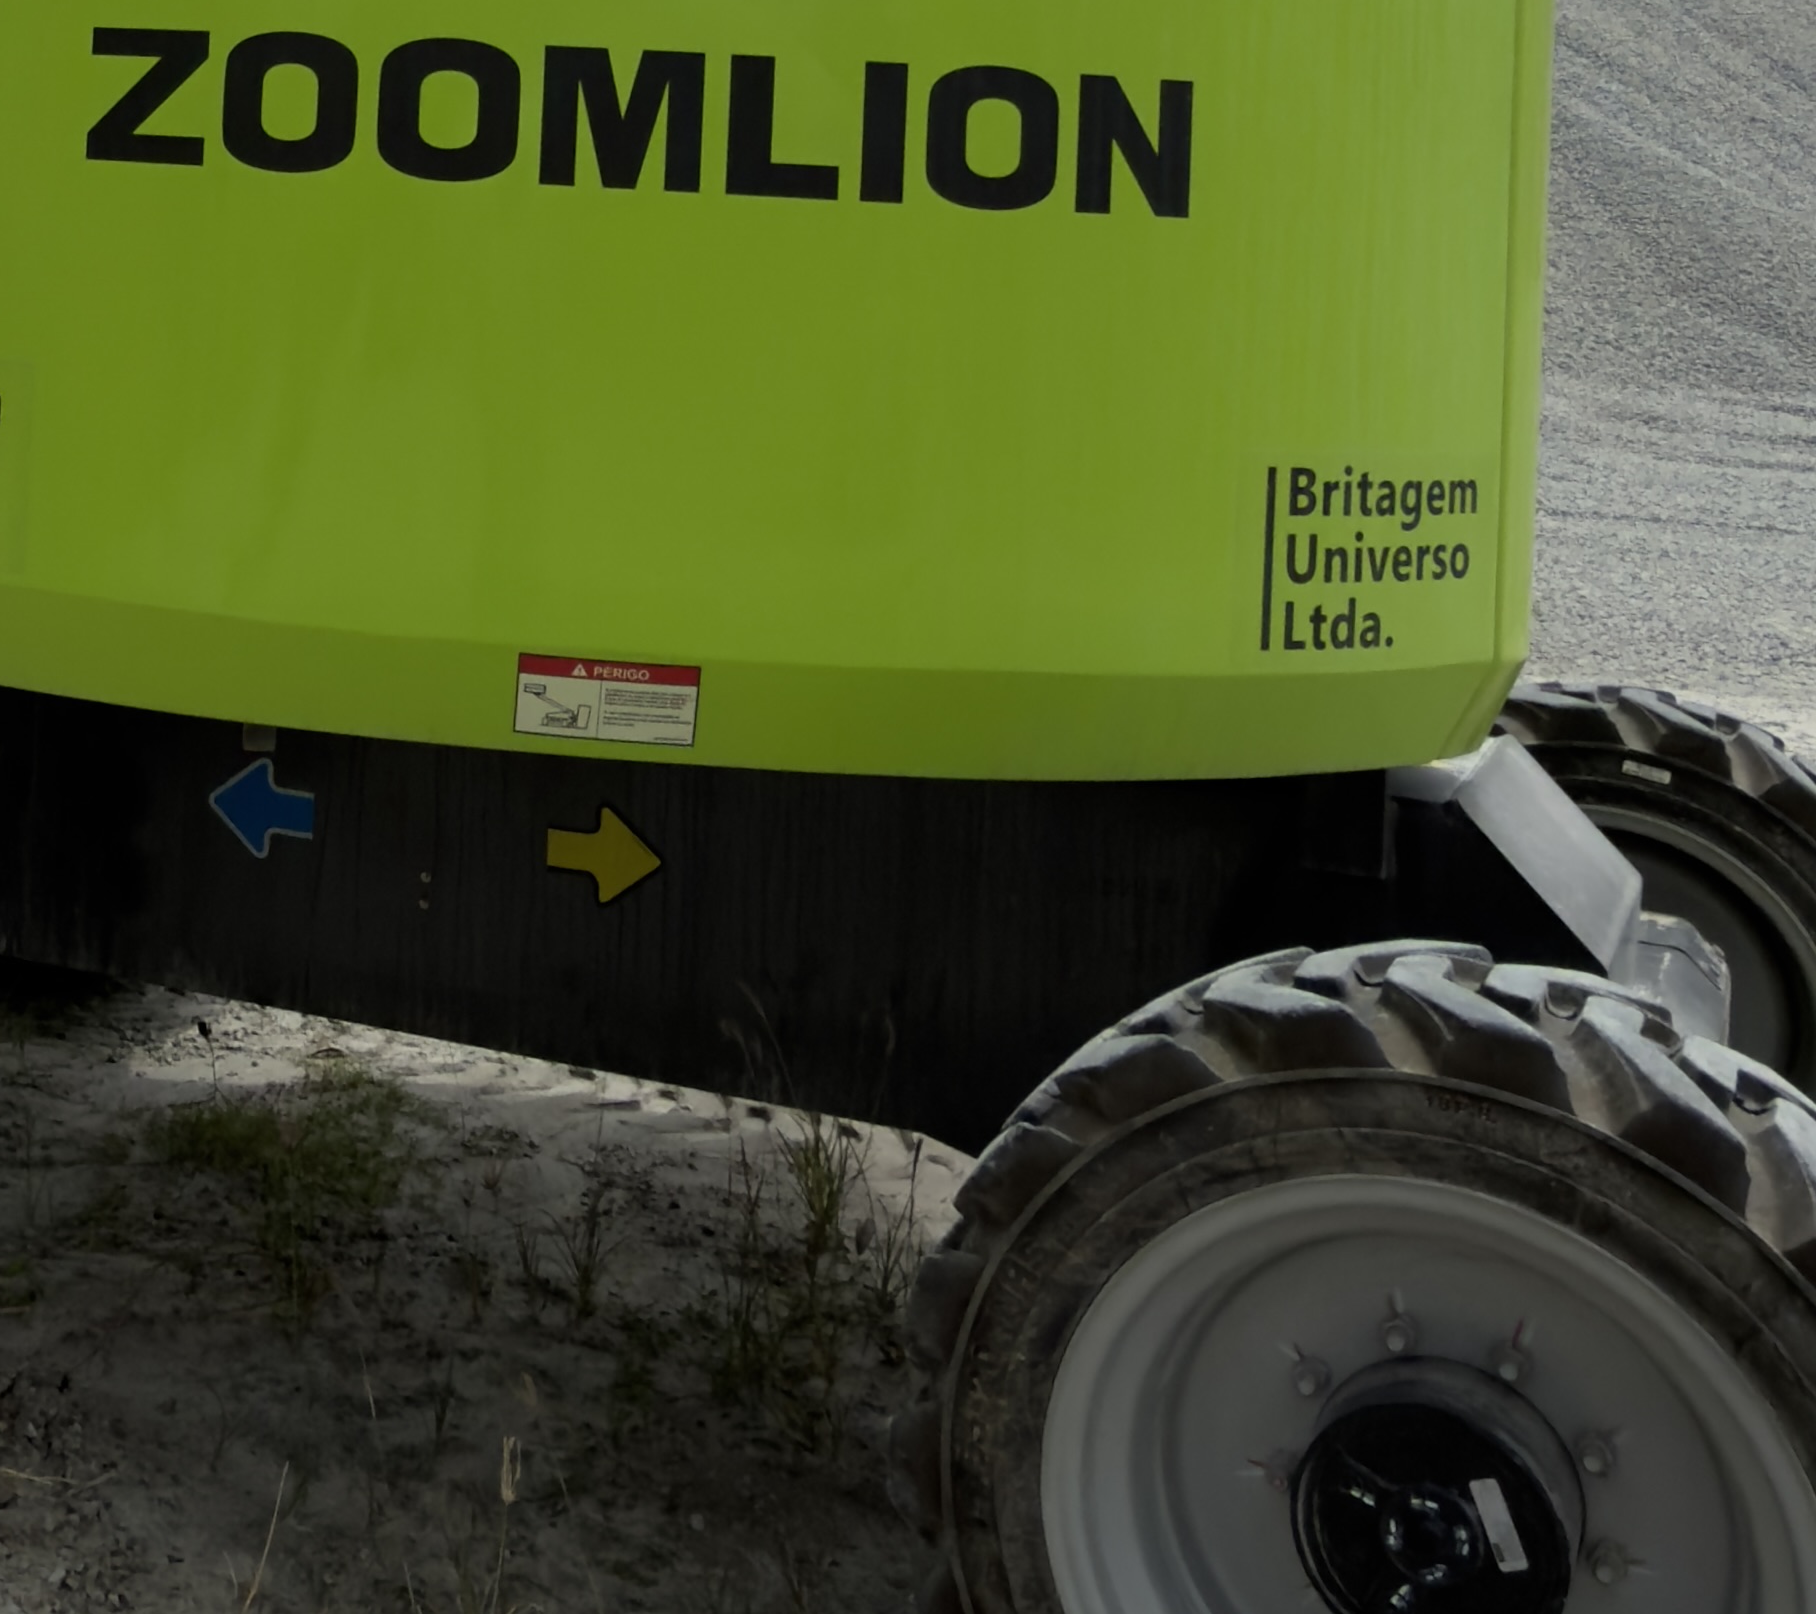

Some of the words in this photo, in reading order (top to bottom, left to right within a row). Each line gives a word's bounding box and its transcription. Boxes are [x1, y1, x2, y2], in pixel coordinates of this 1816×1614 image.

[86, 26, 1195, 219] ZOOMLION
[1288, 464, 1478, 532] Britagem
[1286, 530, 1470, 585] Universo
[1283, 596, 1394, 651] Ltda.
[593, 665, 651, 682] PERIGO
